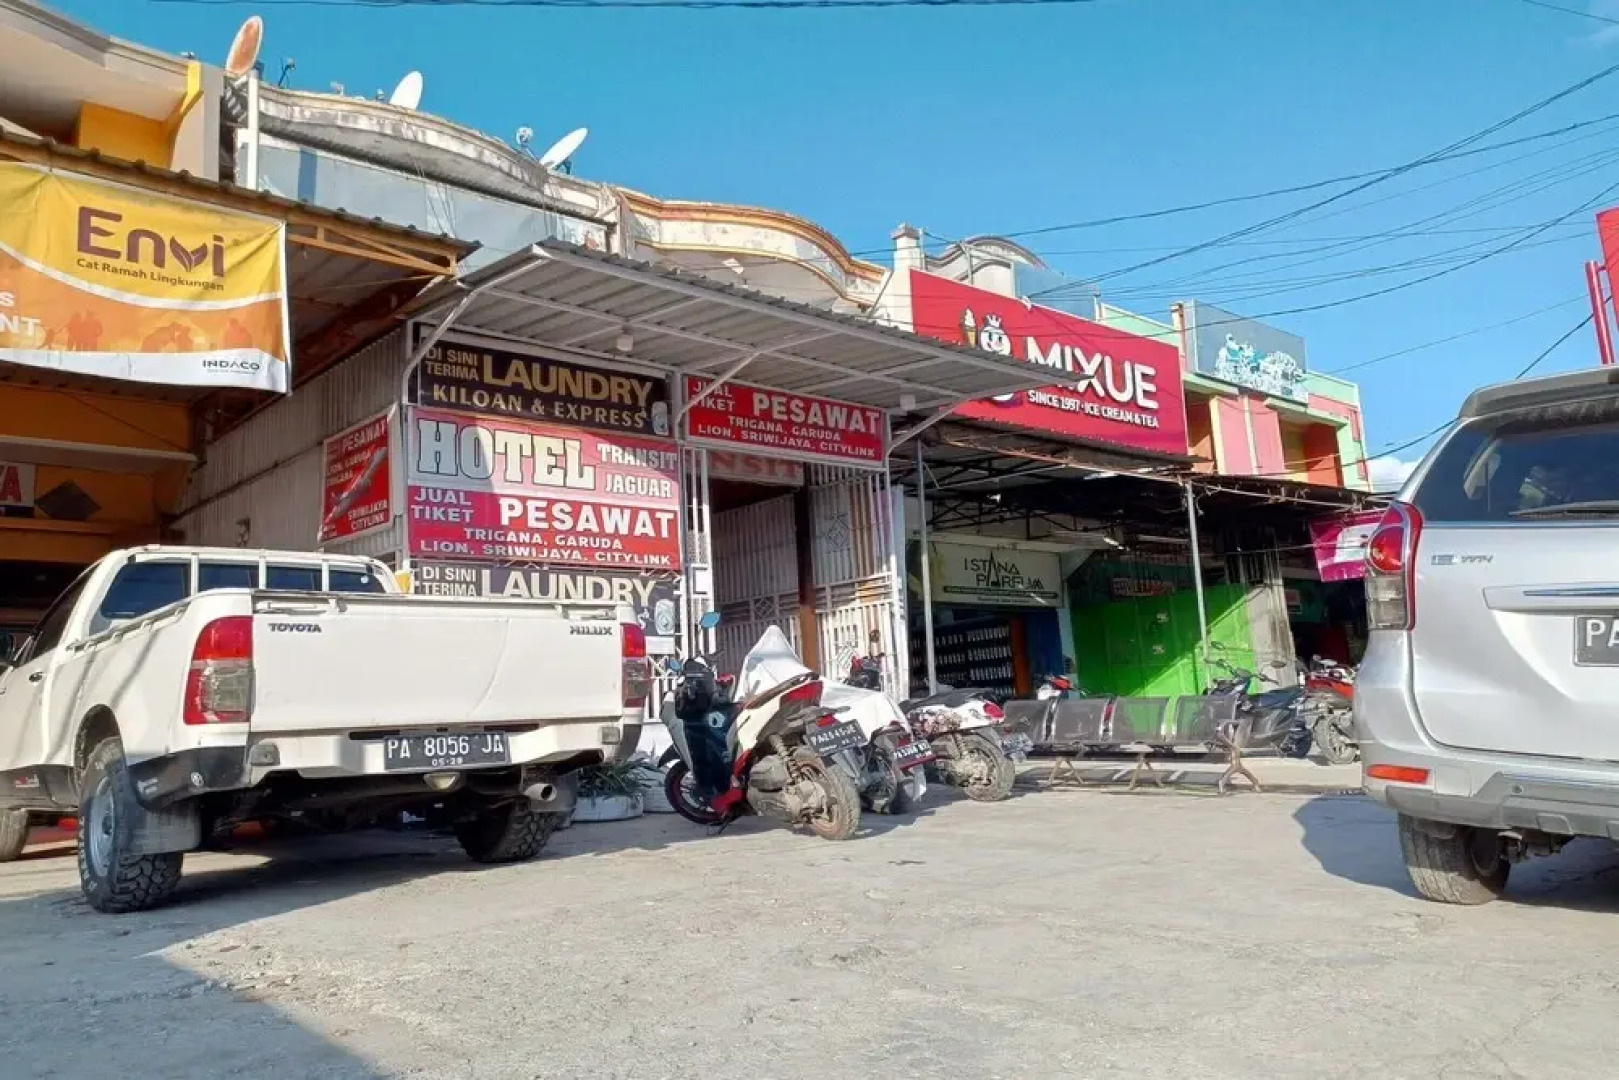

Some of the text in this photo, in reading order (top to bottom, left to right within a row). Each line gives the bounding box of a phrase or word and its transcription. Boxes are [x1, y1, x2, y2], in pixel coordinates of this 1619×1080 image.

[77, 206, 225, 278] Envi
[77, 258, 225, 291] Cat Ramah Lingkungan
[202, 360, 260, 370] INDACO
[425, 347, 479, 367] DI SINI
[425, 361, 480, 381] TERIMA
[483, 354, 654, 407] LAUNDRY
[1026, 336, 1159, 409] MIXUE
[433, 384, 644, 428] KILOAN & EXPRESS
[691, 395, 736, 412] IKET
[752, 391, 880, 435] PESAWAT
[1028, 390, 1059, 408] SINCE
[1085, 402, 1100, 416] ICE
[1142, 414, 1160, 428] TEA
[342, 419, 386, 455] PESAWAT
[698, 424, 875, 458] LION, SRIWIJAYA, CITYLINK
[728, 415, 841, 441] TRIGANA, GARUDA
[417, 418, 595, 490] HOTEL
[597, 443, 678, 470] TRANSIT
[414, 487, 472, 506] JUAL
[605, 473, 672, 498] JAGUAR
[411, 504, 475, 522] TIKET
[499, 498, 675, 538] PESAWAT
[464, 528, 622, 550] TRIGANA, GARUDA
[420, 540, 671, 566] LION, SRIWIJAYA, CITYLINK
[964, 552, 1021, 579] ISTANA
[422, 566, 477, 582] DI SINI
[422, 582, 477, 596] TERIMA
[482, 568, 656, 607] LAUNDRY
[268, 622, 322, 634] TOYOTA
[569, 625, 613, 636] HILUX
[388, 734, 504, 759] PA 8056 JA
